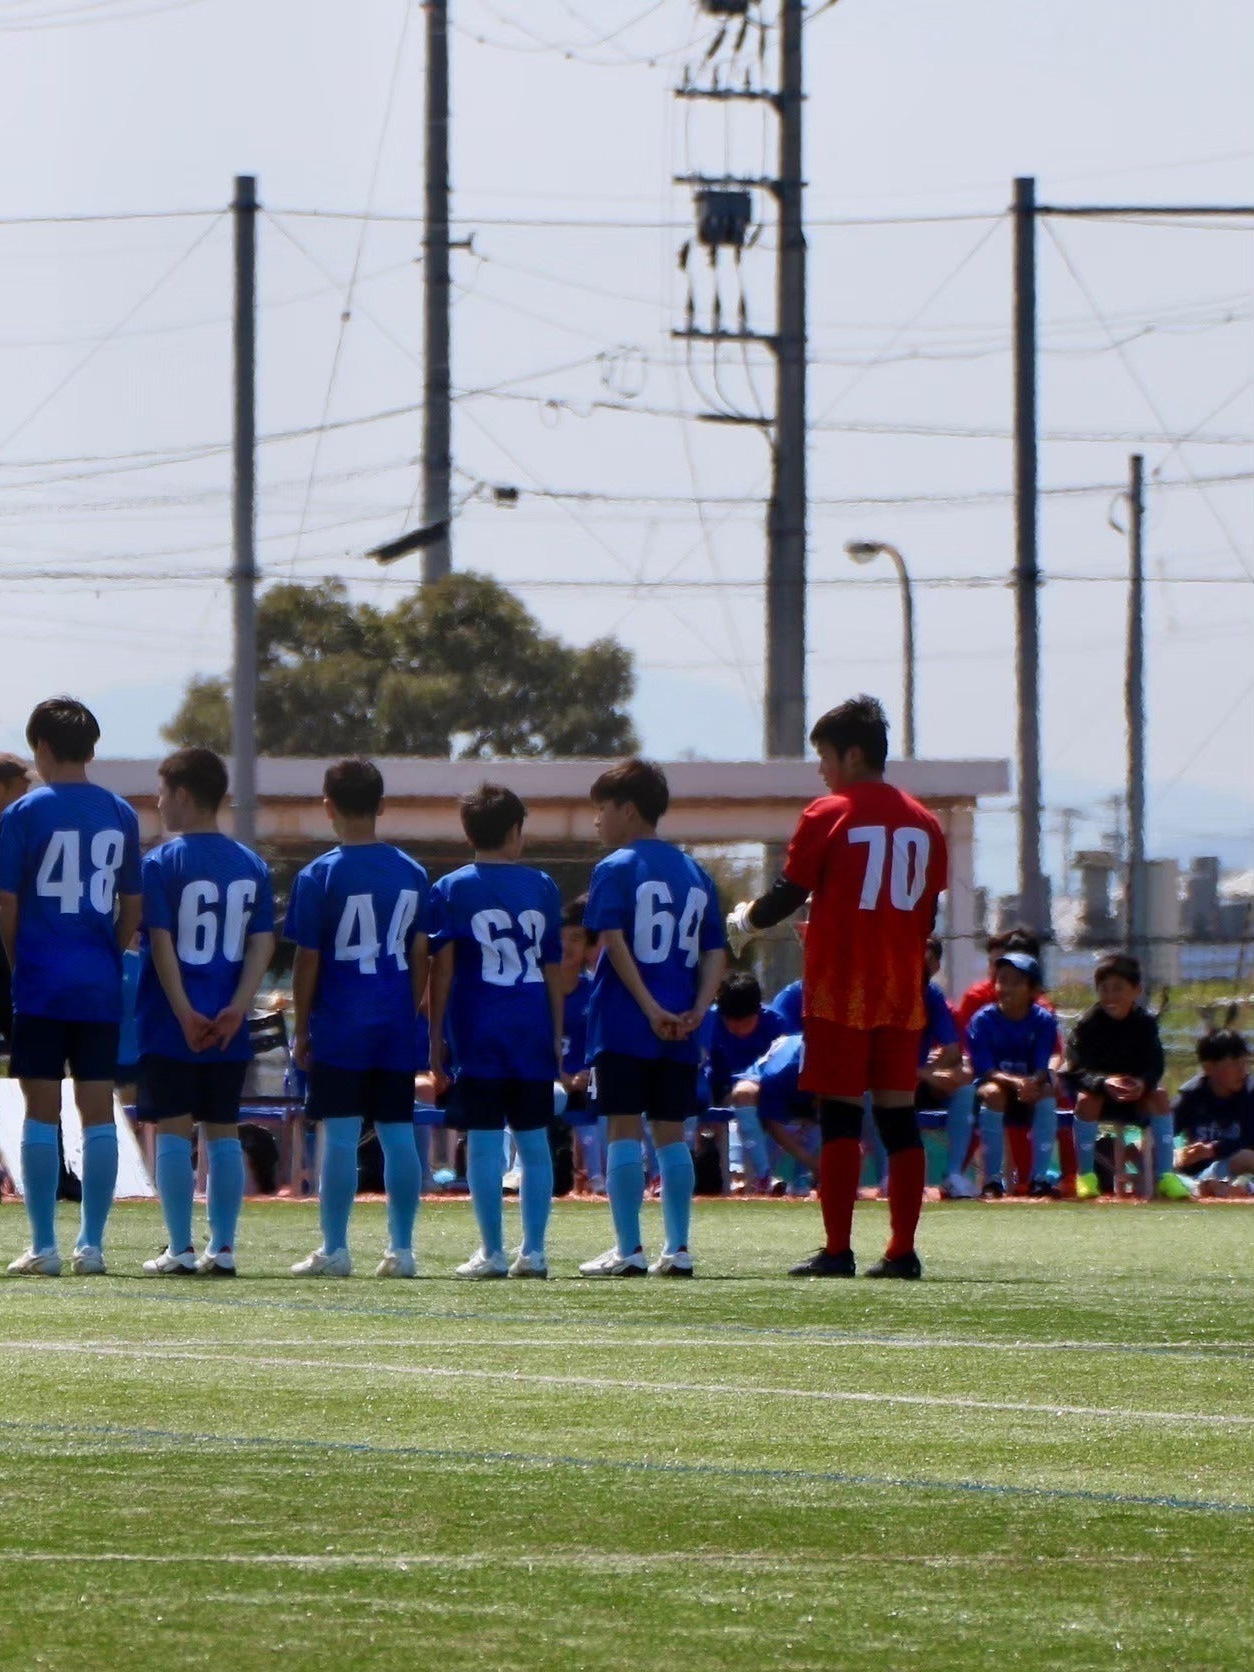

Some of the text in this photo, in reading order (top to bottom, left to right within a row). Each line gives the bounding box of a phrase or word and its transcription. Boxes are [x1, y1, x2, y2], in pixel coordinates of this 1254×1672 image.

[36, 829, 125, 913] 48
[847, 824, 931, 911] 70
[178, 879, 258, 965] 66
[334, 889, 419, 975] 44
[470, 908, 546, 986] 62
[634, 880, 708, 968] 64
